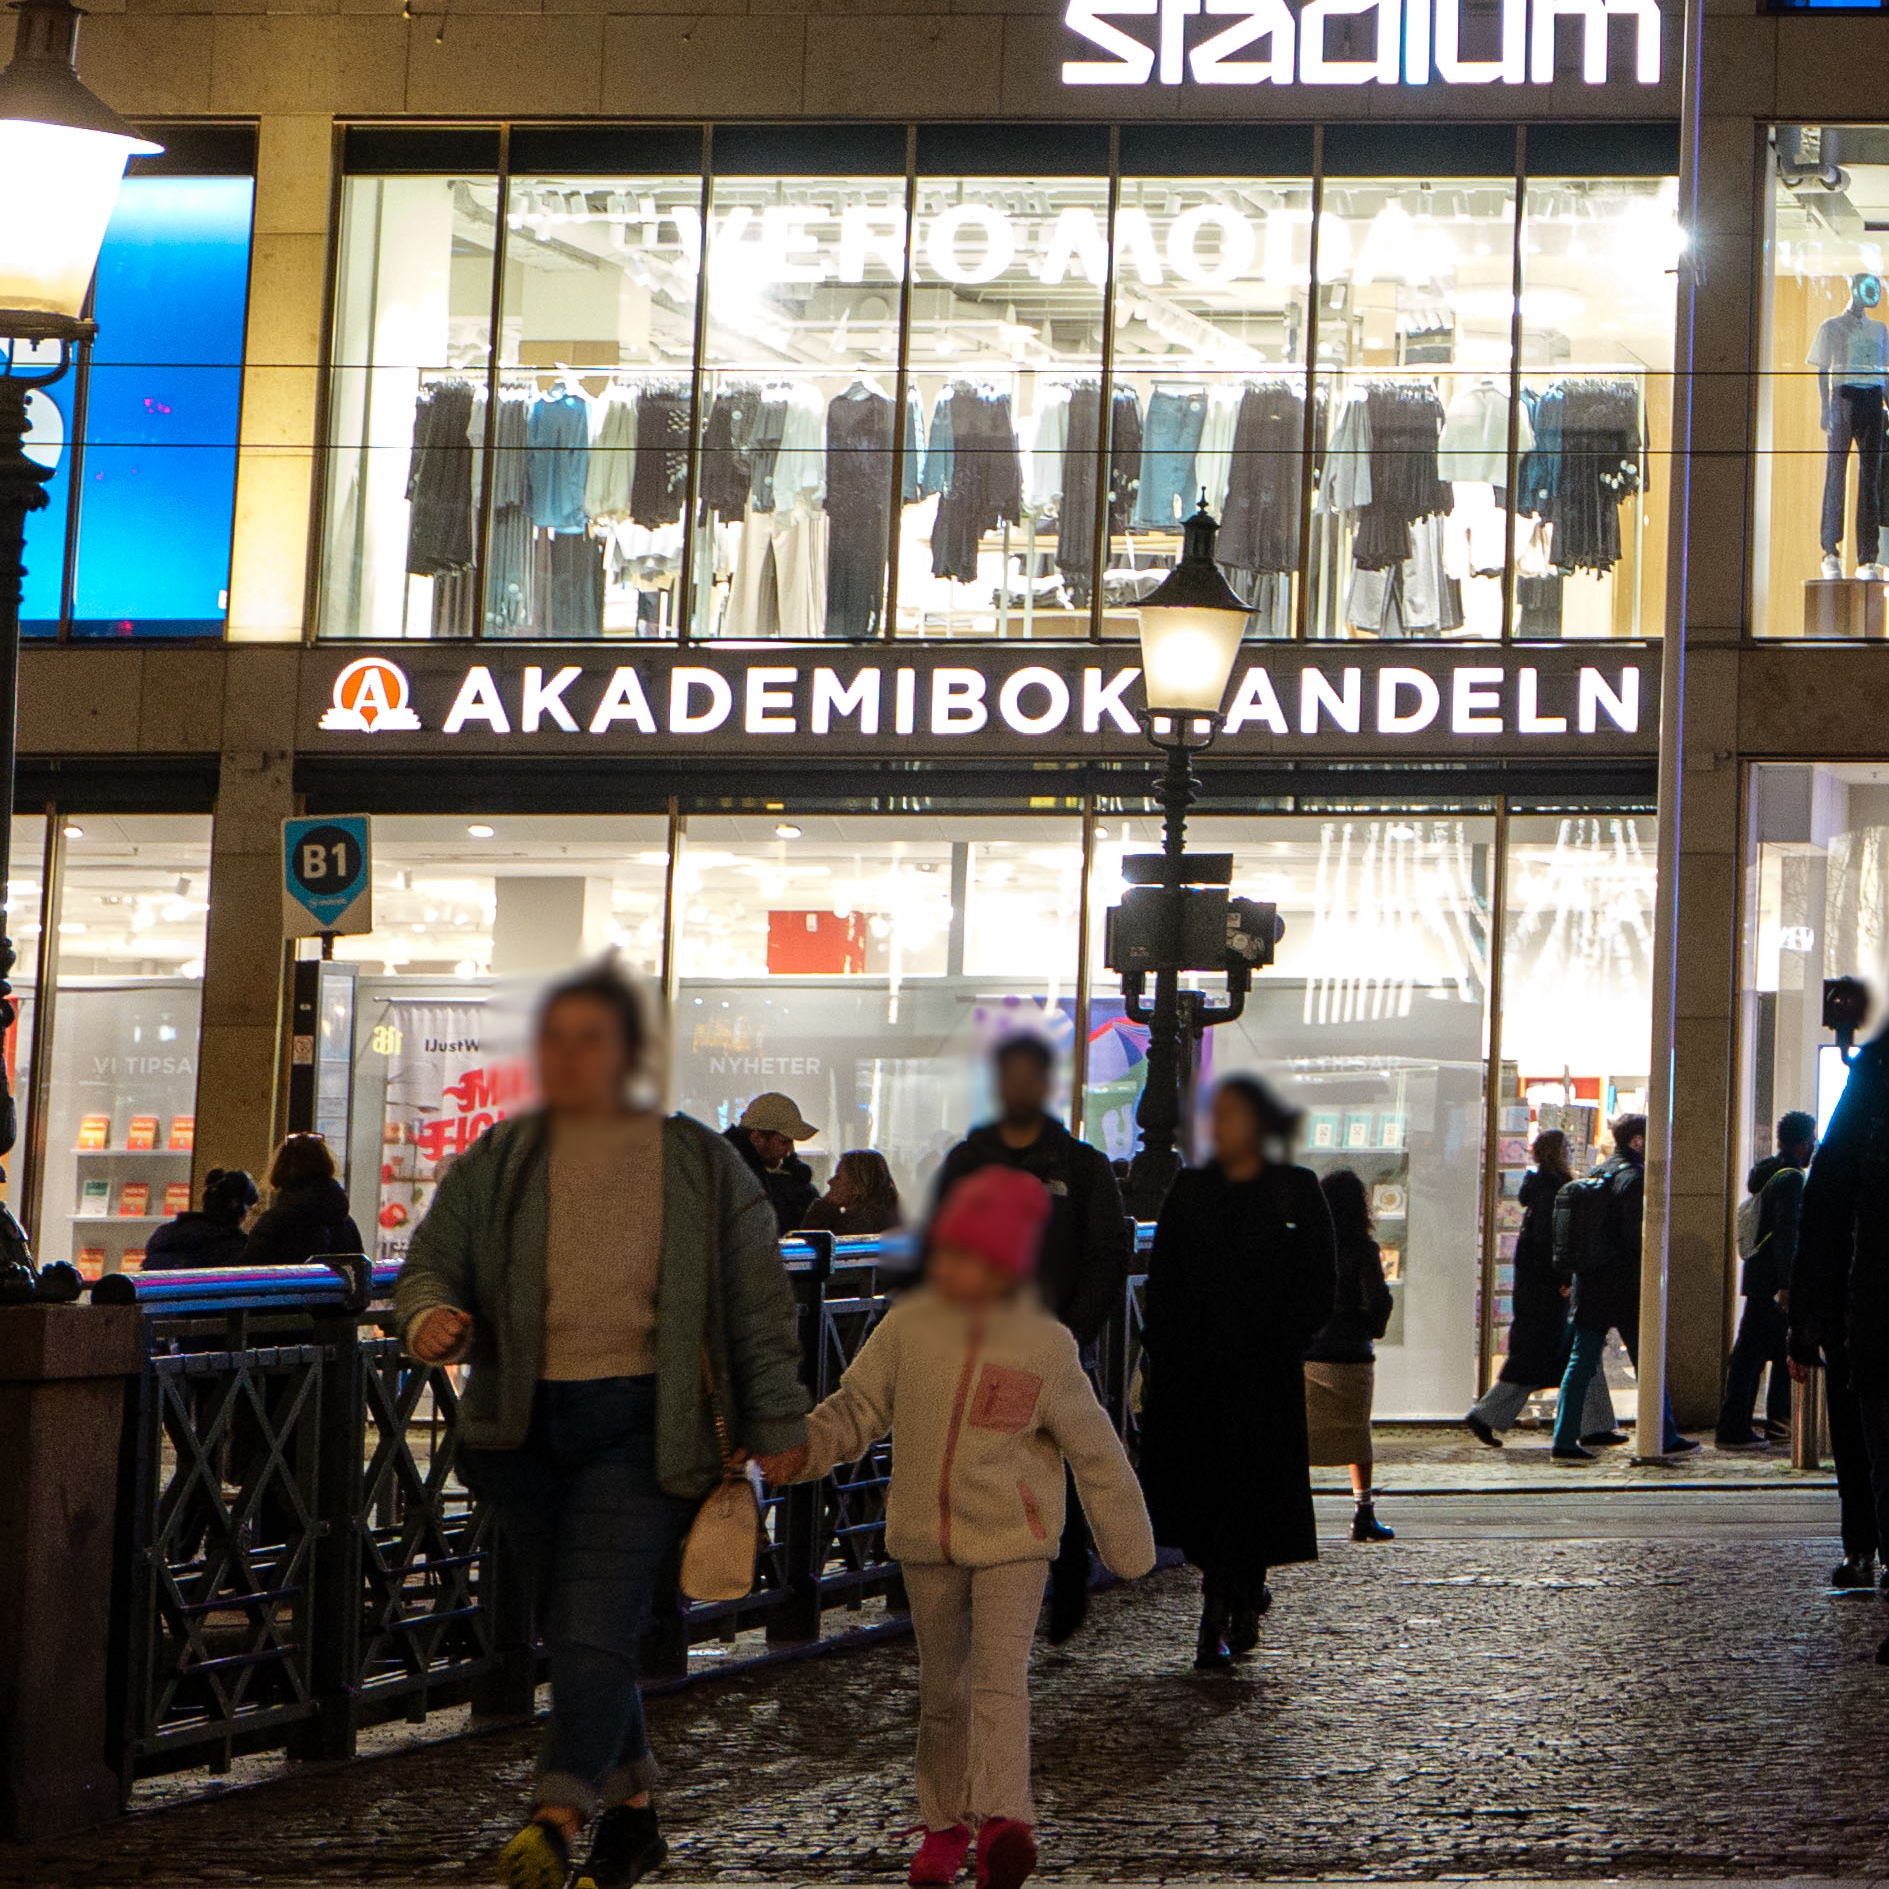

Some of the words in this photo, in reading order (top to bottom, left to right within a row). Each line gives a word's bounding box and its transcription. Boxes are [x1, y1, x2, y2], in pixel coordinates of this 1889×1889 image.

[444, 667, 1641, 735] AKADEMIBOKANDELN
[302, 842, 347, 879] B1
[124, 1056, 193, 1075] TIPSA
[709, 1056, 822, 1075] NYHETER
